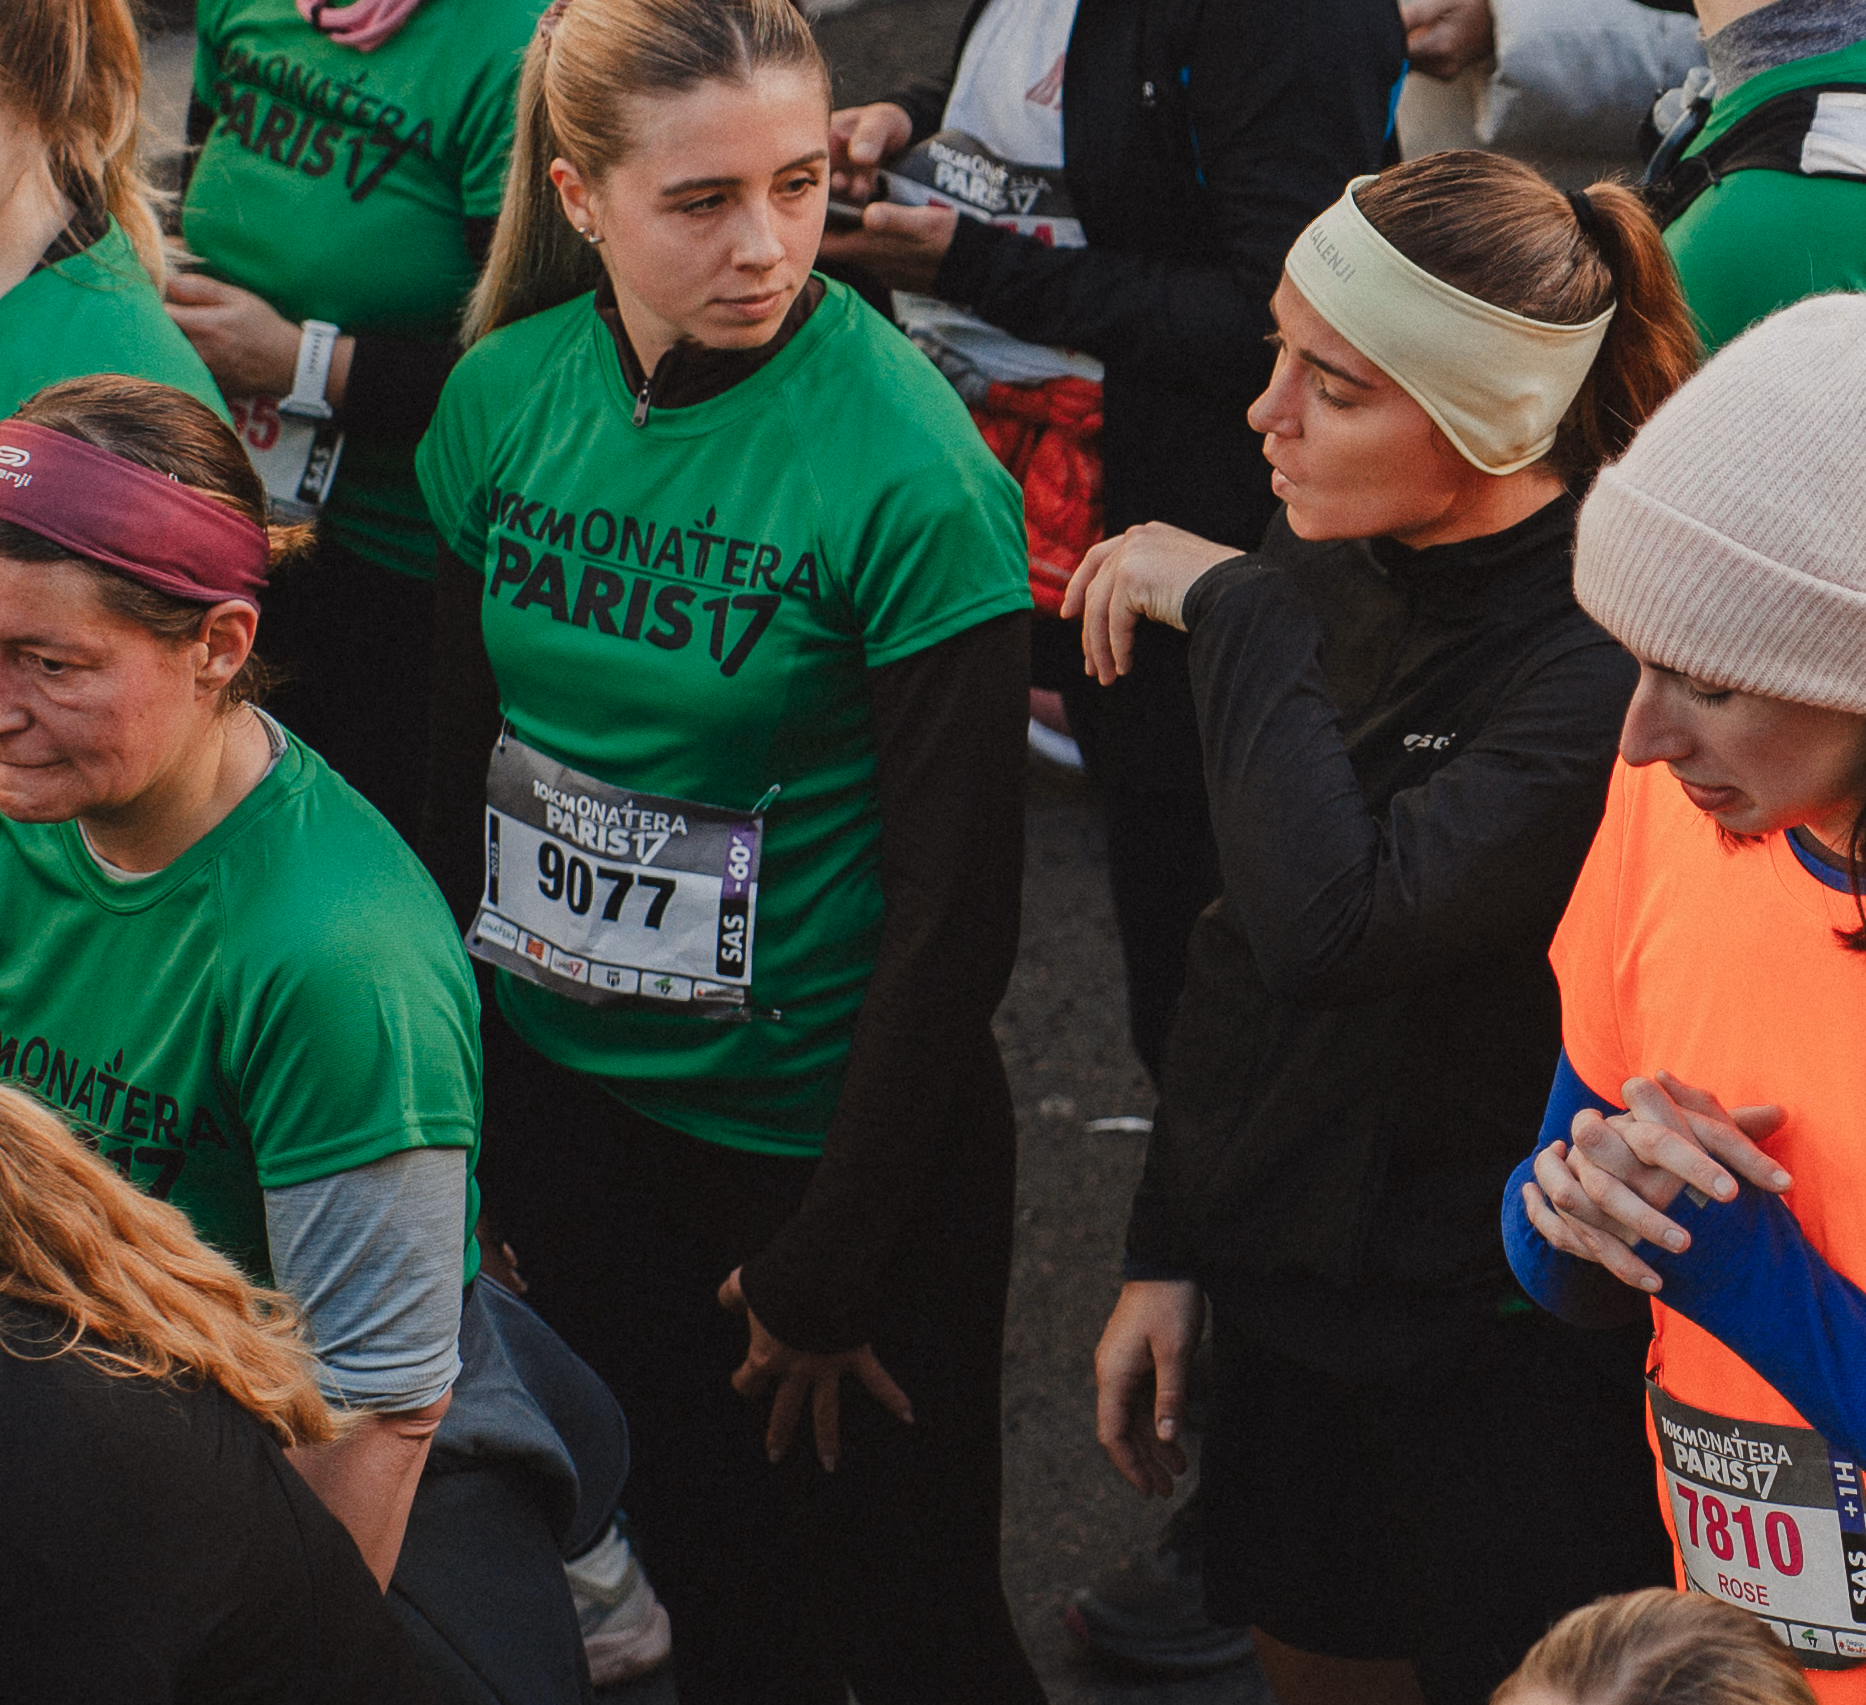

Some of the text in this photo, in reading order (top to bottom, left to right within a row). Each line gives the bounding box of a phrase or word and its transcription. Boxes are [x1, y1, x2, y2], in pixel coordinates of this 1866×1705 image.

[1307, 224, 1357, 284] KALENJI
[488, 536, 782, 678] PARIS17
[546, 804, 670, 866] PARIS17
[538, 840, 677, 931] 9077
[721, 914, 745, 964] SAS
[1661, 1415, 1793, 1467] 10KMONATERA
[1672, 1440, 1779, 1501] PARIS17
[1675, 1481, 1805, 1577] 7810
[1717, 1572, 1771, 1607] ROSE
